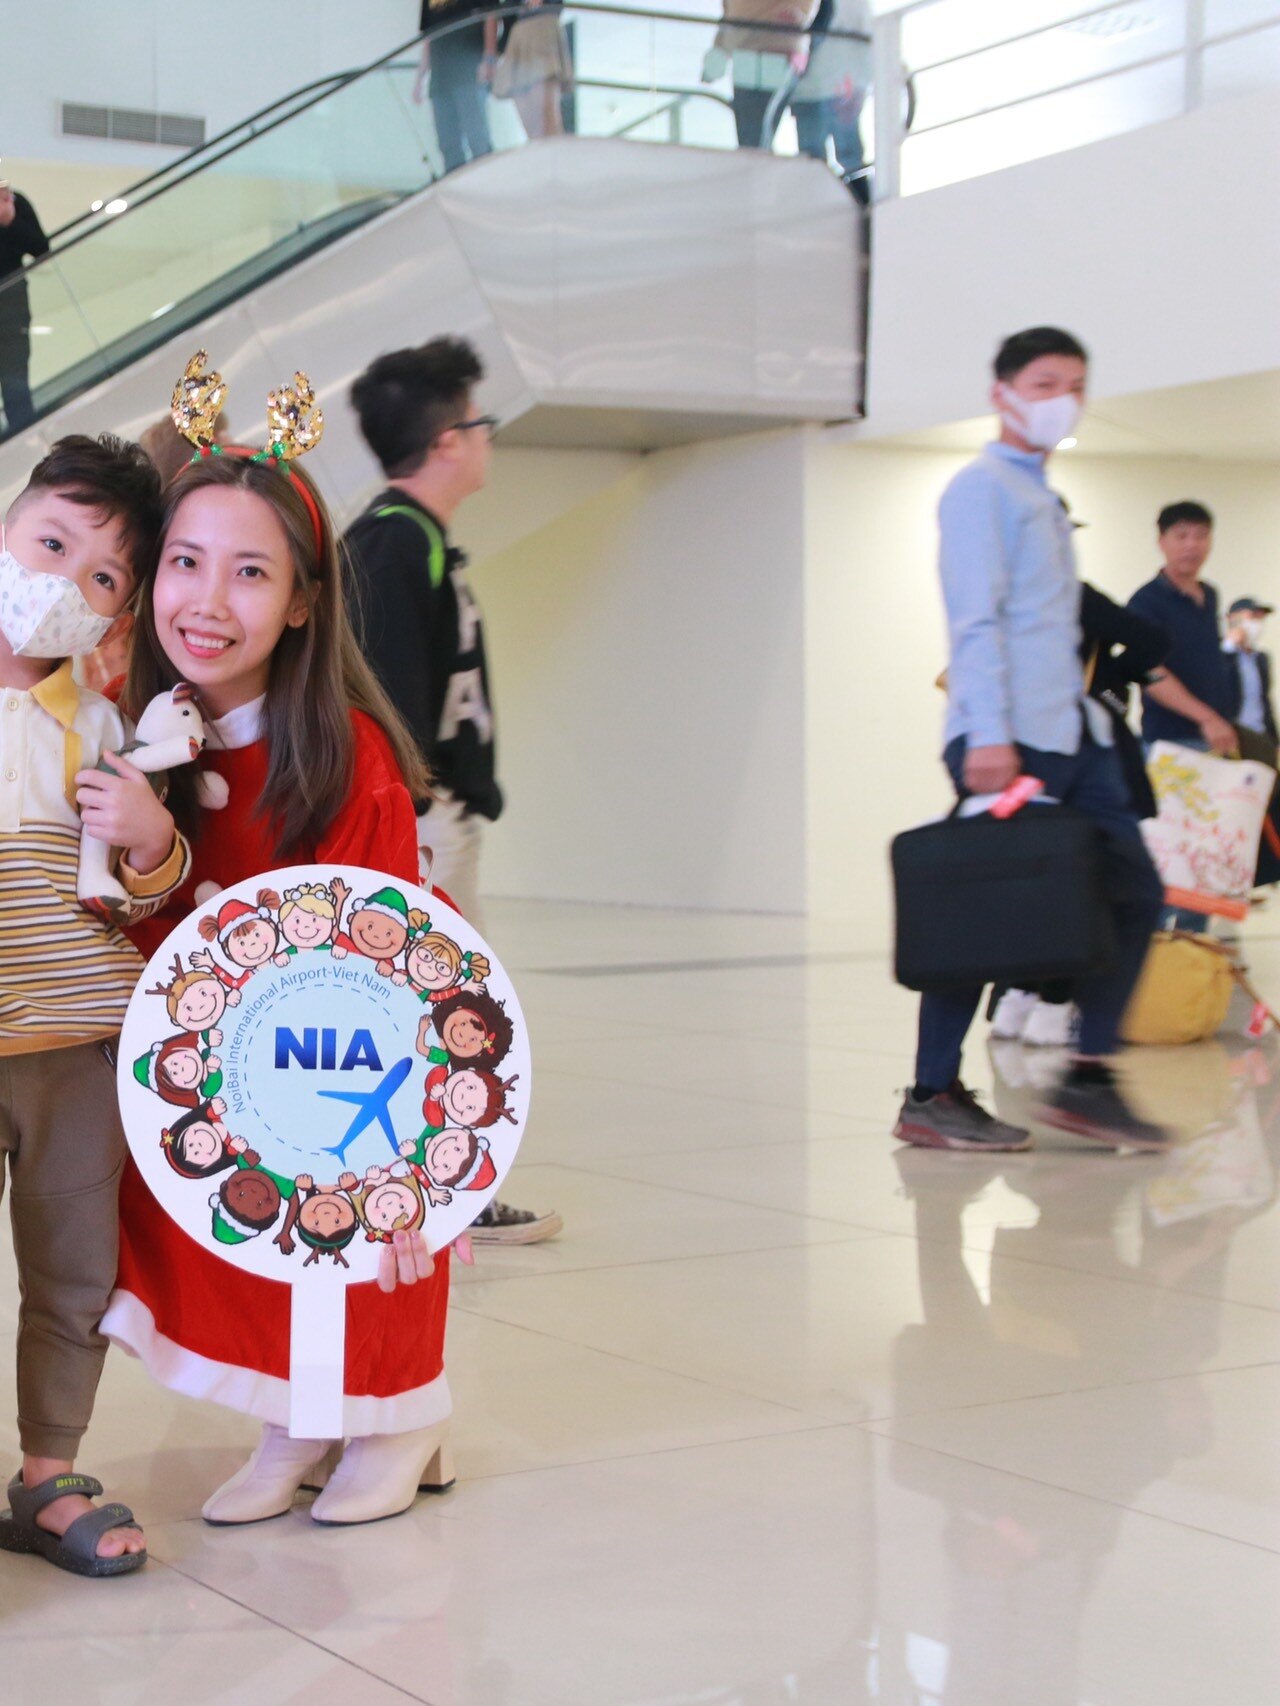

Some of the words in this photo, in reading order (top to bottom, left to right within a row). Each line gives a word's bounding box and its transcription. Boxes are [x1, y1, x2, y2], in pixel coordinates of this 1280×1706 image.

[361, 973, 392, 999] Nam
[228, 983, 280, 1065] International
[274, 1026, 384, 1072] NIA
[226, 1068, 246, 1114] NoiBai
